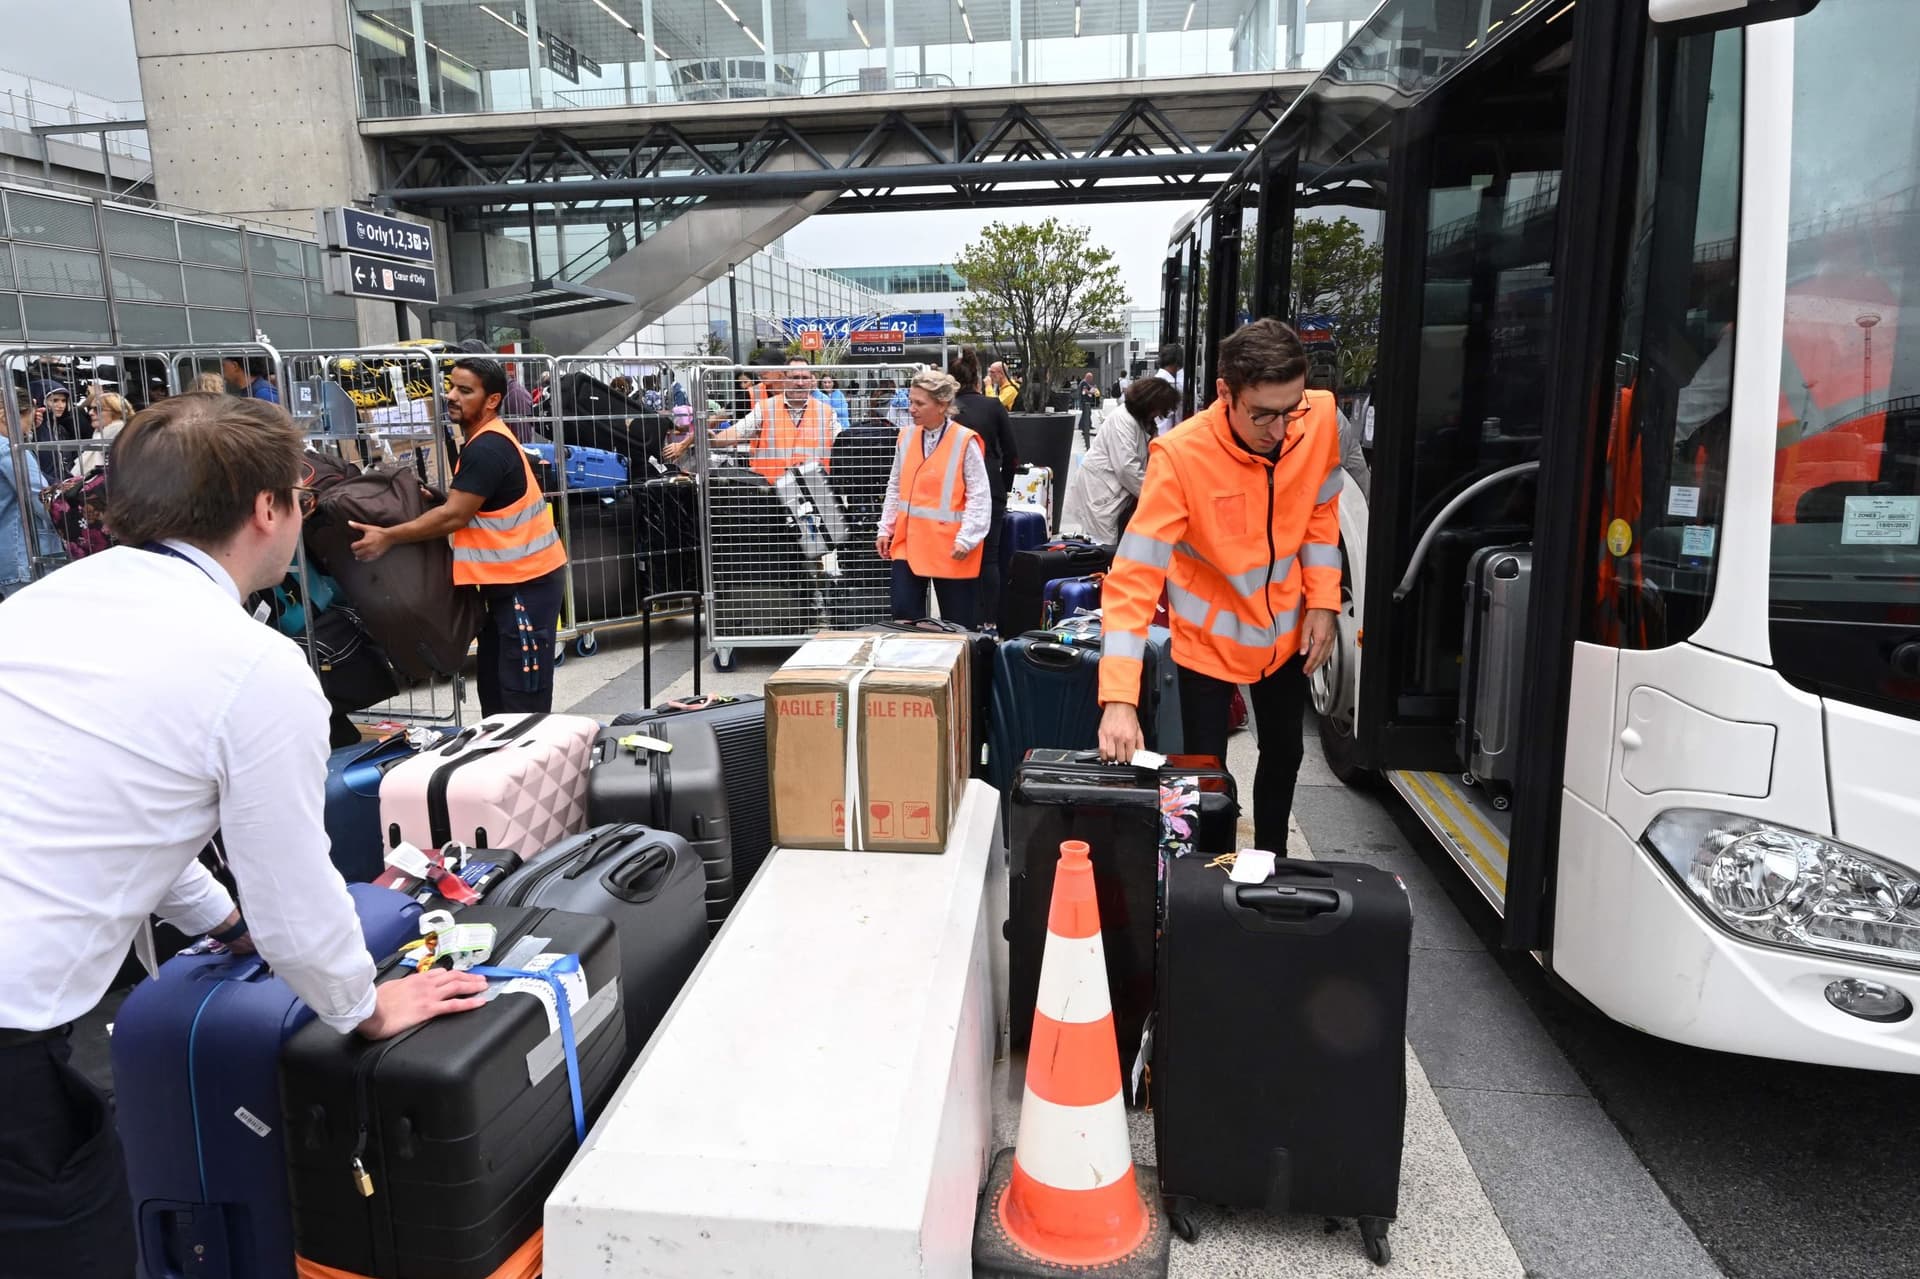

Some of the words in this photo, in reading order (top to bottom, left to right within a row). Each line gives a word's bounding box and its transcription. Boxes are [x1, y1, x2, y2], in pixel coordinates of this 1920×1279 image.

[366, 224, 388, 247] Orly
[891, 320, 917, 333] 42d
[775, 700, 824, 716] AGILE
